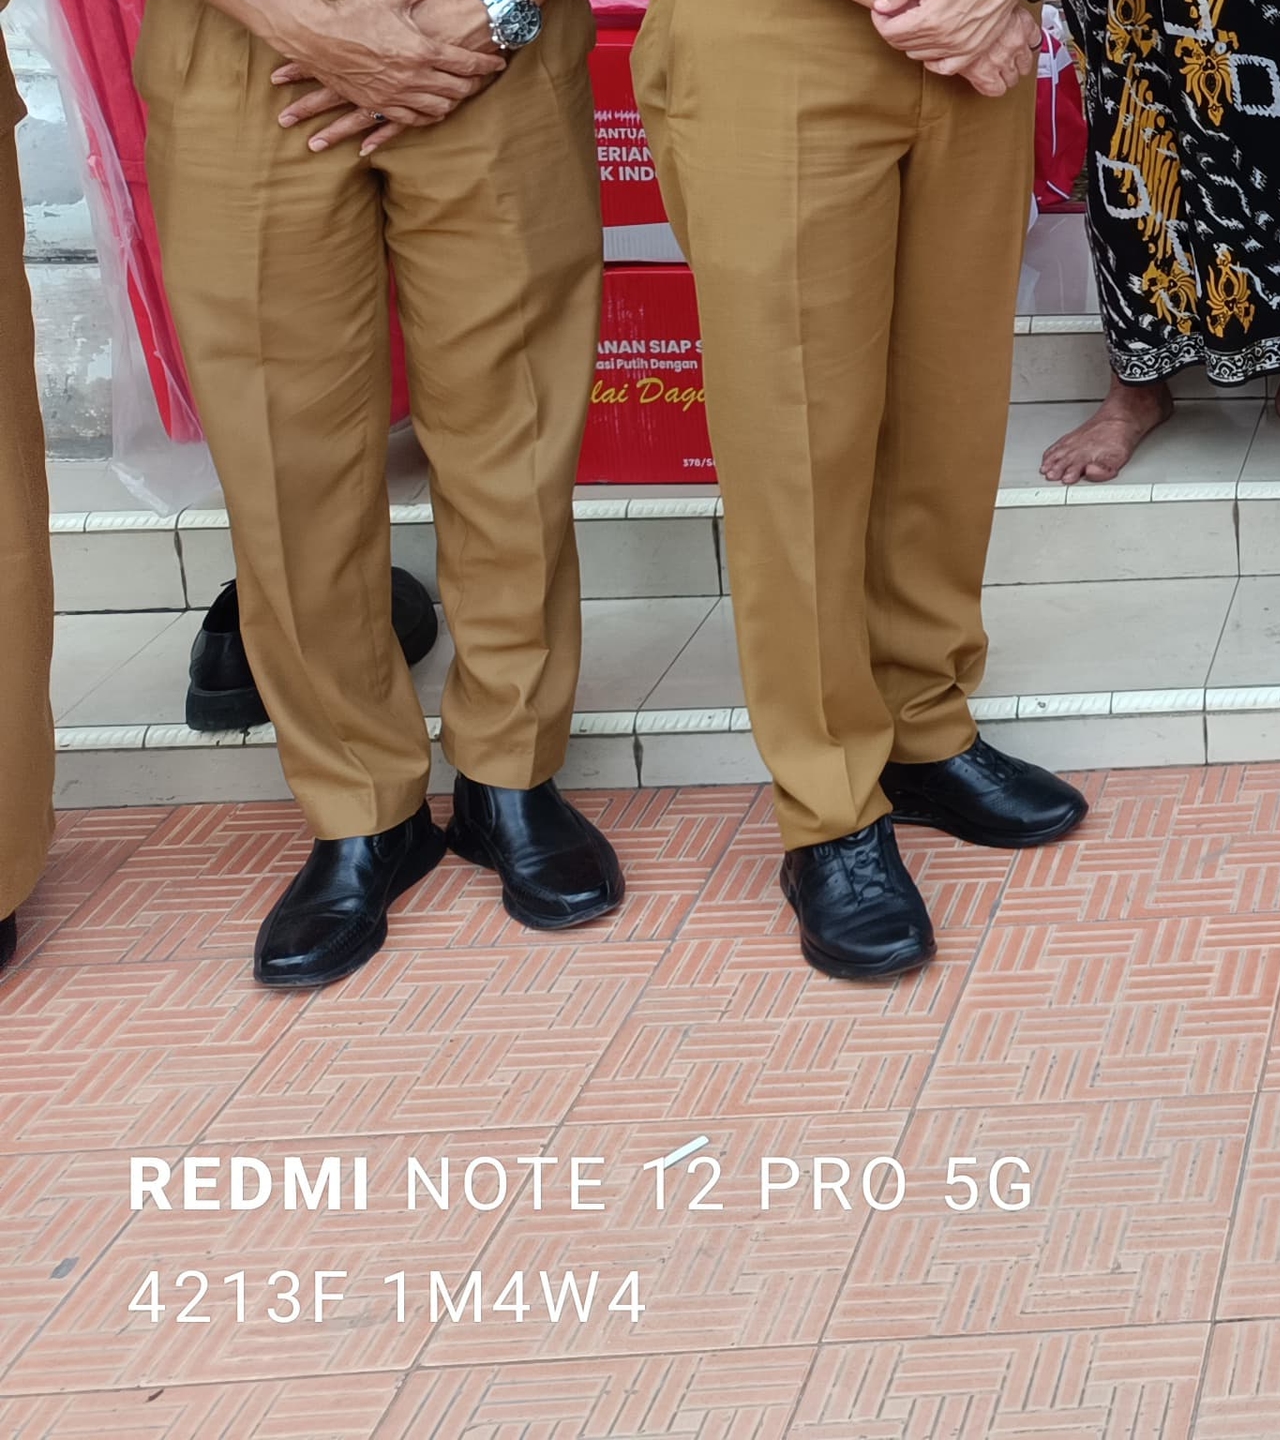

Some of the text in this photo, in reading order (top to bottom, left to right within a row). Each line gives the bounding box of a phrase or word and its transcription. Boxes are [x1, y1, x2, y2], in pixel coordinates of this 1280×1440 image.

[600, 166, 614, 181] K
[649, 340, 692, 353] SIAP
[616, 358, 648, 370] Putih
[650, 359, 698, 372] Dengan
